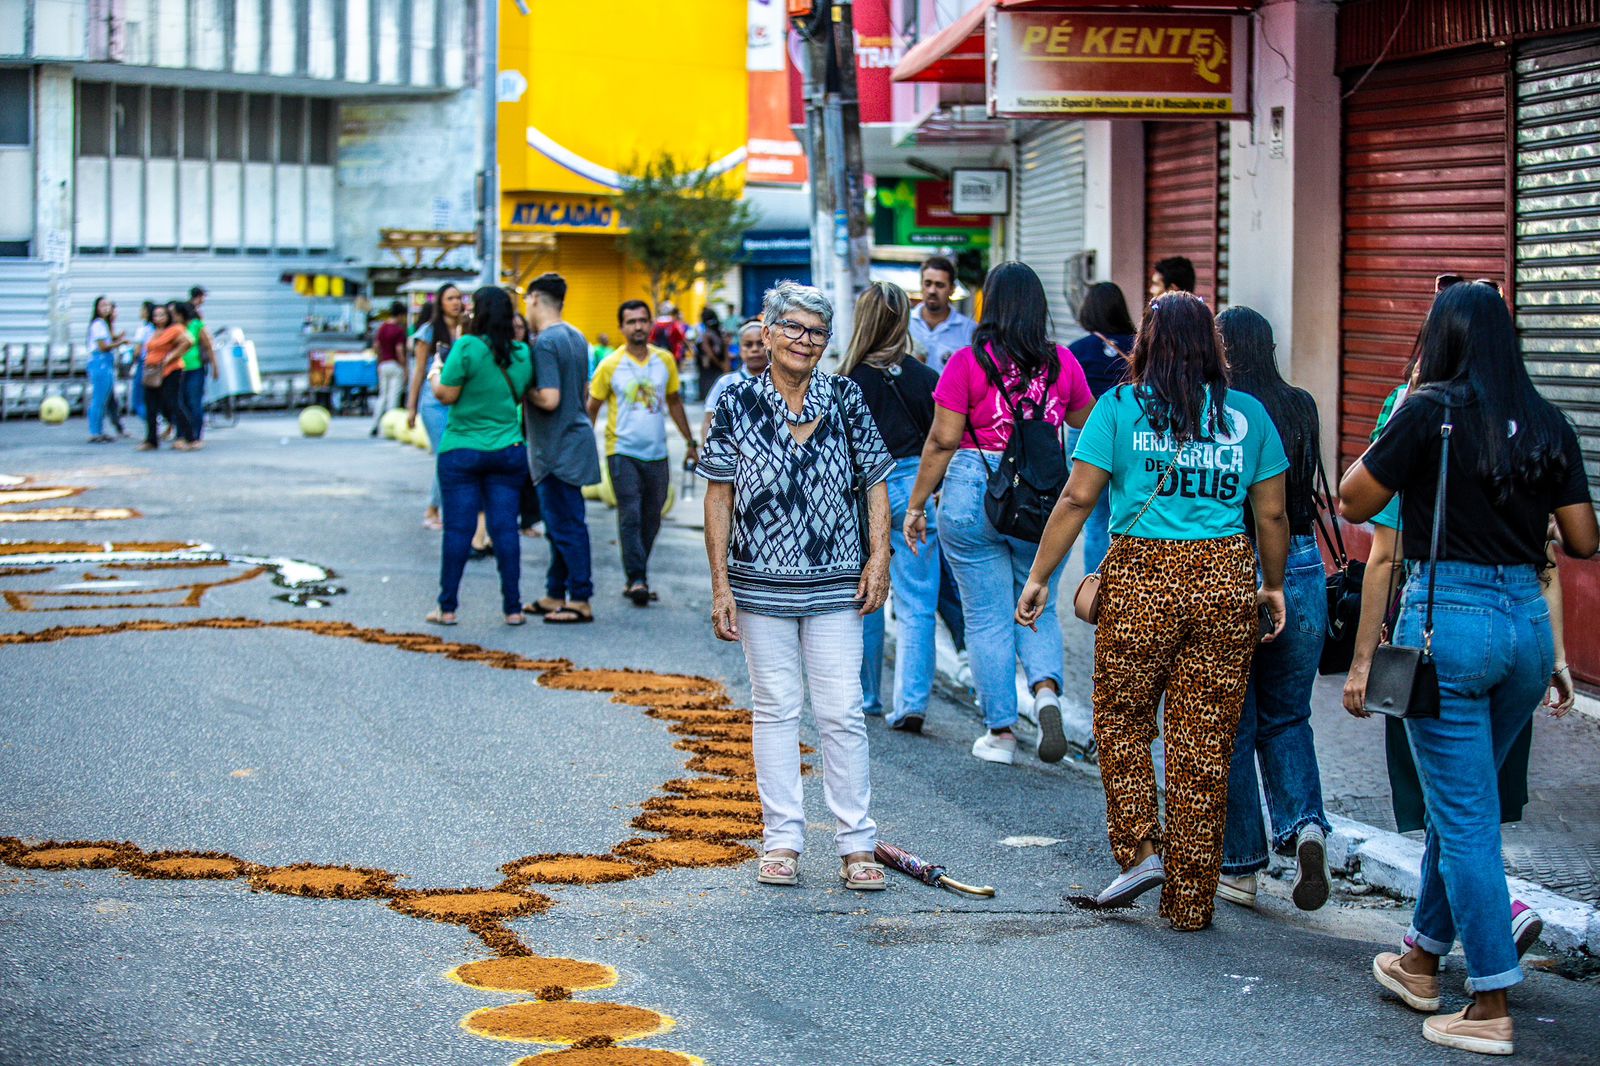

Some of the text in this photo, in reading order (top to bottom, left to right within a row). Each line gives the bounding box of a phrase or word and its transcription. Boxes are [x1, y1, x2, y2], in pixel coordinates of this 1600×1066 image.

[1023, 20, 1216, 55] PÉ KENTE
[512, 198, 612, 227] ATACADÃO
[1145, 457, 1166, 472] DE
[1177, 444, 1244, 473] GRAÇA
[1156, 467, 1240, 501] DEUS
